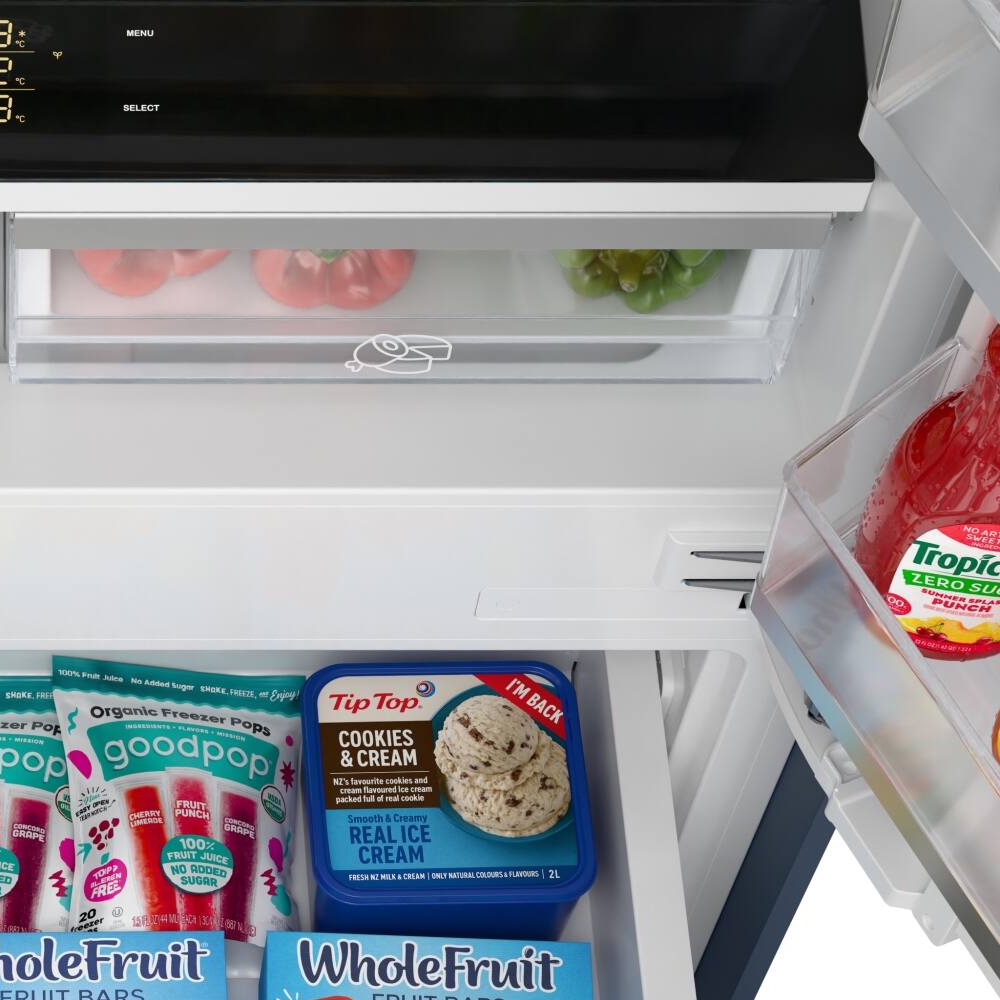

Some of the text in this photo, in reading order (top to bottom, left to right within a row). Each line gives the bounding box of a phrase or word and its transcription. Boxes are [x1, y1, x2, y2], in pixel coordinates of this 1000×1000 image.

[126, 29, 154, 37] MENU
[123, 104, 160, 113] SELECT
[963, 525, 980, 534] NO
[911, 572, 965, 590] ZERO
[921, 588, 967, 603] SUMMER
[932, 597, 992, 613] PUNCH
[58, 669, 124, 683] 100% Fruit Juice
[130, 677, 195, 692] No Added Sugar
[329, 692, 420, 714] Tip Top
[504, 677, 566, 726] I'M BACK
[90, 705, 272, 737] Organic Freezer Pops
[338, 729, 414, 748] COOKIES
[103, 734, 269, 780] goodpop
[340, 749, 418, 768] & CREAM
[333, 776, 428, 786] NZ's favourite cookies and
[340, 785, 433, 795] cream flavoured ice cream
[175, 799, 207, 810] FRUIT
[335, 794, 425, 805] packed full of real cookie
[128, 809, 161, 821] CHERRY
[174, 807, 210, 820] PUNCH
[347, 814, 429, 826] Smooth & Creamy
[12, 823, 47, 834] CONCORD
[129, 815, 164, 829] LIMEADE
[12, 829, 46, 843] GRAPE
[223, 823, 256, 840] GRAPE
[350, 824, 432, 845] REAL ICE
[178, 837, 214, 851] 100%
[166, 849, 230, 866] FRUIT JUICE
[358, 845, 425, 865] CREAM
[170, 863, 227, 879] NO ADDED
[348, 873, 369, 882] FRESH
[370, 873, 380, 881] NZ
[380, 873, 397, 881] MILK
[403, 872, 426, 880] CREAM
[431, 872, 448, 881] ONLY
[448, 871, 476, 880] NATURAL
[475, 871, 503, 880] COLOURS
[508, 870, 540, 879] FLAVOURS
[548, 869, 561, 879] 2L
[180, 875, 218, 888] SUGAR
[90, 880, 122, 900] FREE
[79, 908, 97, 922] 20
[70, 917, 104, 932] freezer
[298, 939, 562, 991] WholeFruit
